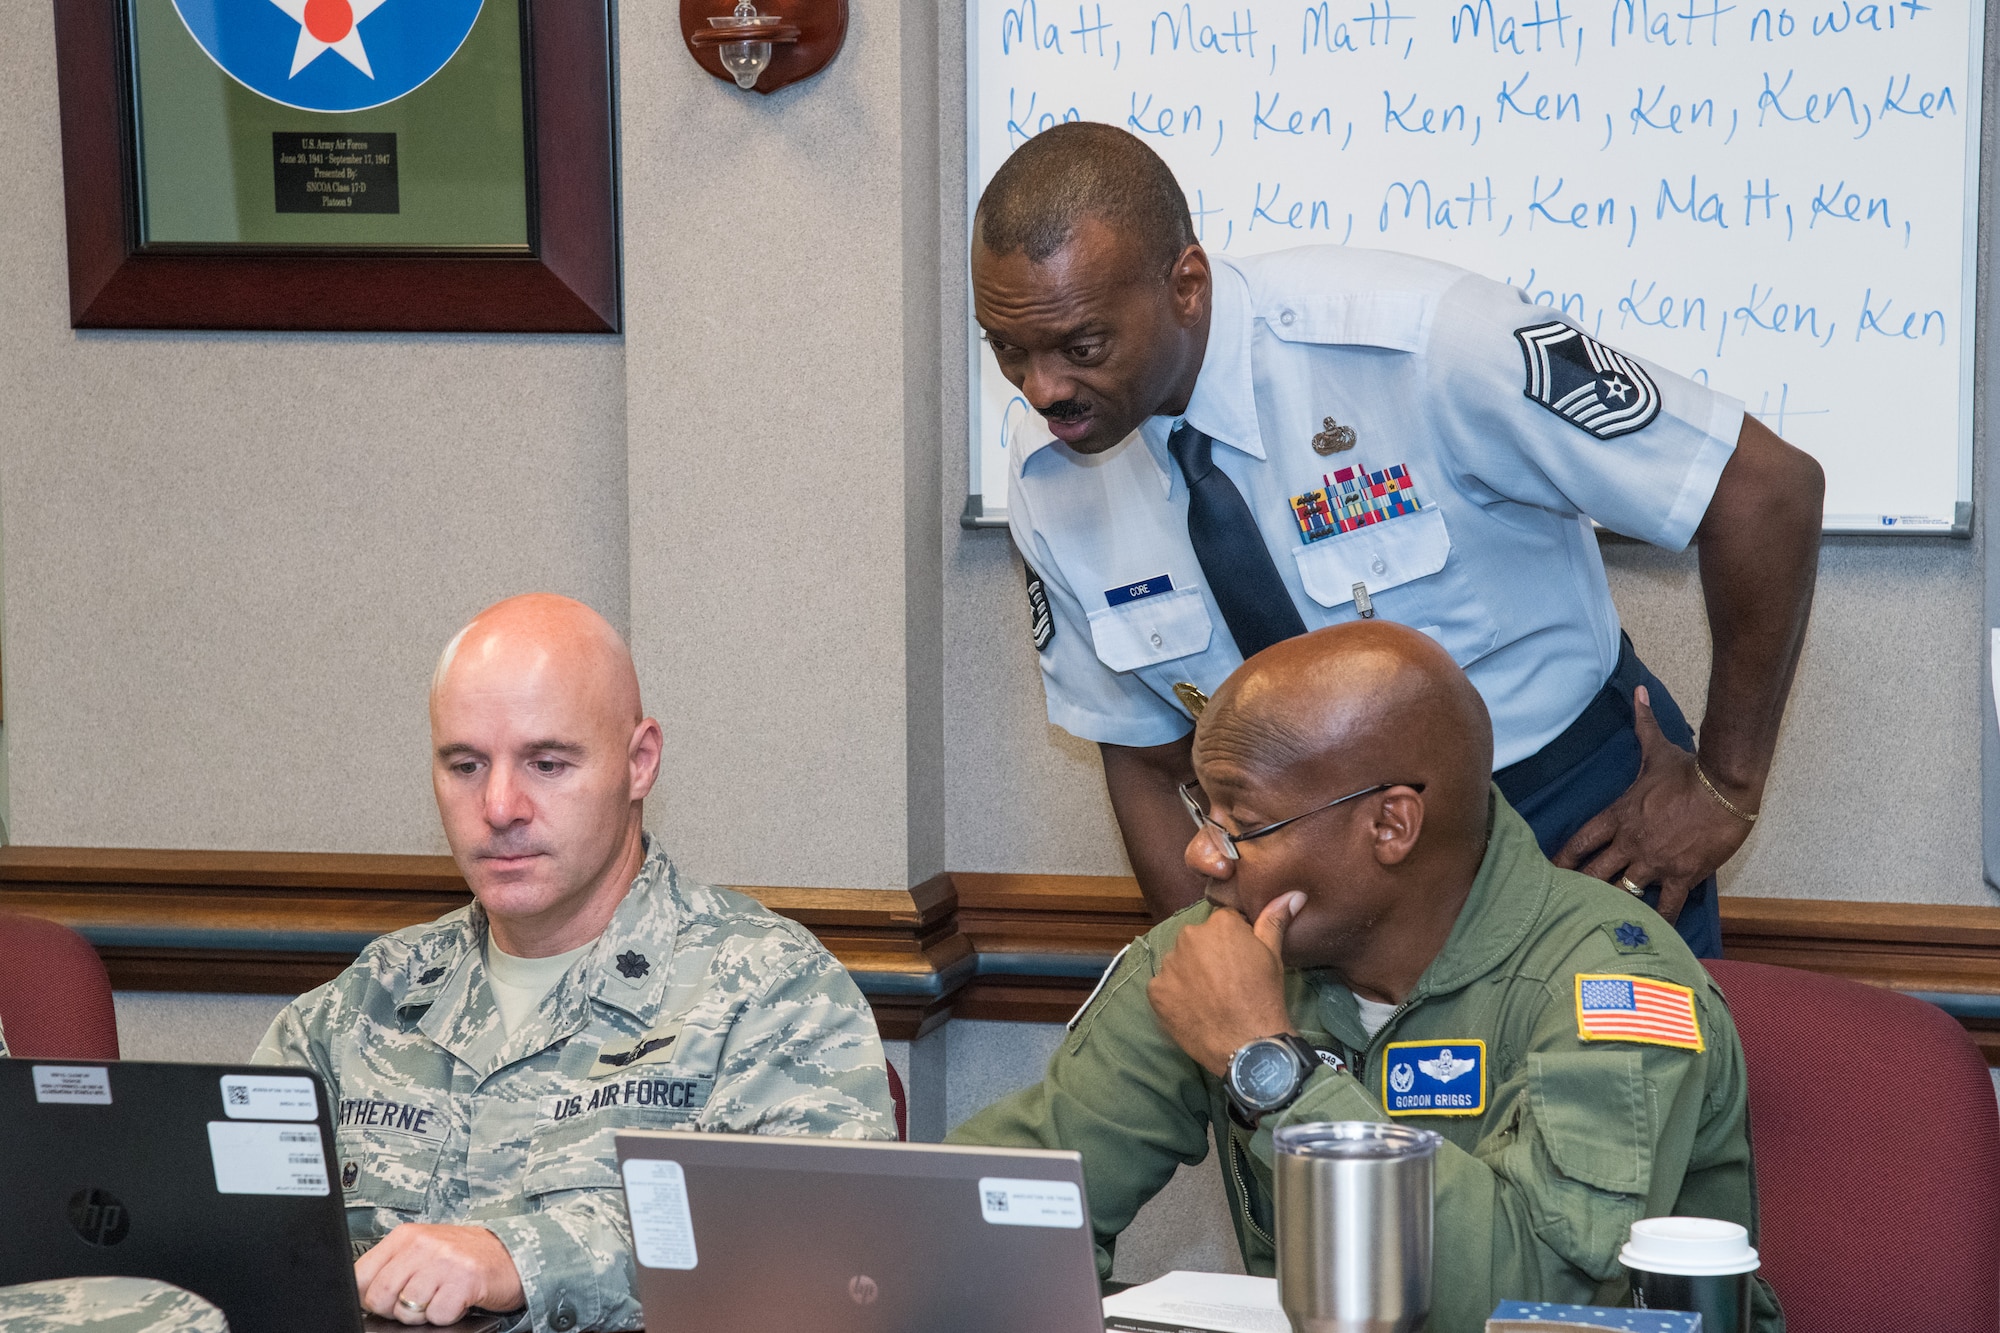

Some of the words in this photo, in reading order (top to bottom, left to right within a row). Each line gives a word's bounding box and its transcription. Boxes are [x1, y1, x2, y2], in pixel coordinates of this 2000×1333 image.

[1003, 0, 1120, 70] Matt,
[1150, 3, 1276, 76] Matt,
[1302, 0, 1413, 60] Matt,
[1452, 0, 1583, 66] Matt,
[1611, 0, 1736, 47] Matt
[1750, 8, 1795, 43] no
[1128, 92, 1223, 156] Ken,
[1253, 91, 1352, 150] Ken,
[1383, 90, 1480, 146] Ken,
[1630, 85, 1737, 144] Ken,
[1758, 69, 1871, 140] Ken,
[1879, 73, 1957, 120] Ken
[317, 139, 334, 151] Army
[335, 139, 346, 150] Air
[347, 139, 368, 150] Forces
[280, 153, 296, 164] June
[329, 153, 363, 165] September
[314, 168, 346, 178] Presented
[332, 182, 350, 192] Class
[322, 196, 346, 207] Platoon
[347, 197, 352, 207] 9
[1248, 182, 1352, 246] Ken,
[1379, 176, 1513, 237] Matt,
[1529, 175, 1637, 248] Ken,
[1855, 287, 1946, 347] Ken
[1129, 583, 1151, 597] CORE
[587, 1083, 620, 1112] AIR
[624, 1079, 697, 1108] FORCE
[1395, 1094, 1431, 1108] GORDON
[1435, 1094, 1472, 1106] GRIGGS
